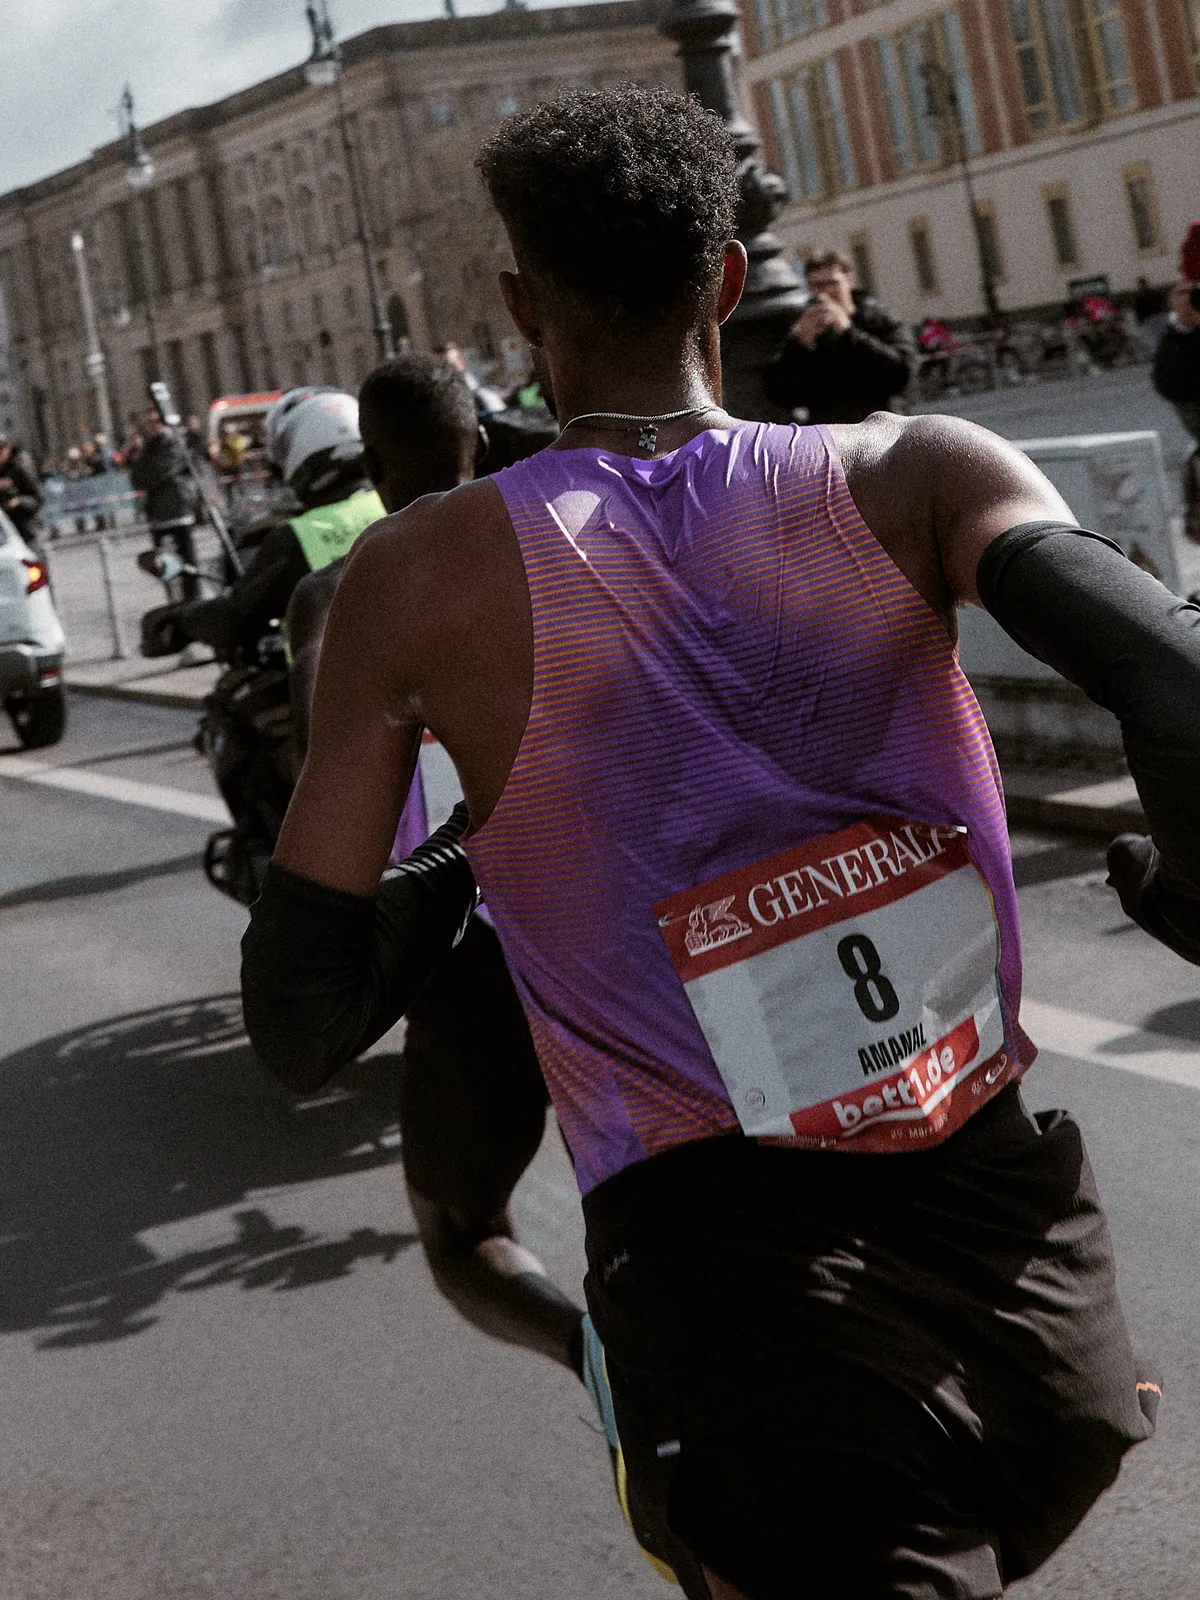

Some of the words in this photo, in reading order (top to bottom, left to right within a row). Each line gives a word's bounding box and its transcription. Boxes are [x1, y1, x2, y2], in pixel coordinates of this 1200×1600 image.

[836, 933, 901, 1024] 8
[833, 1043, 956, 1130] bett1.de
[857, 1021, 927, 1077] AMANAL
